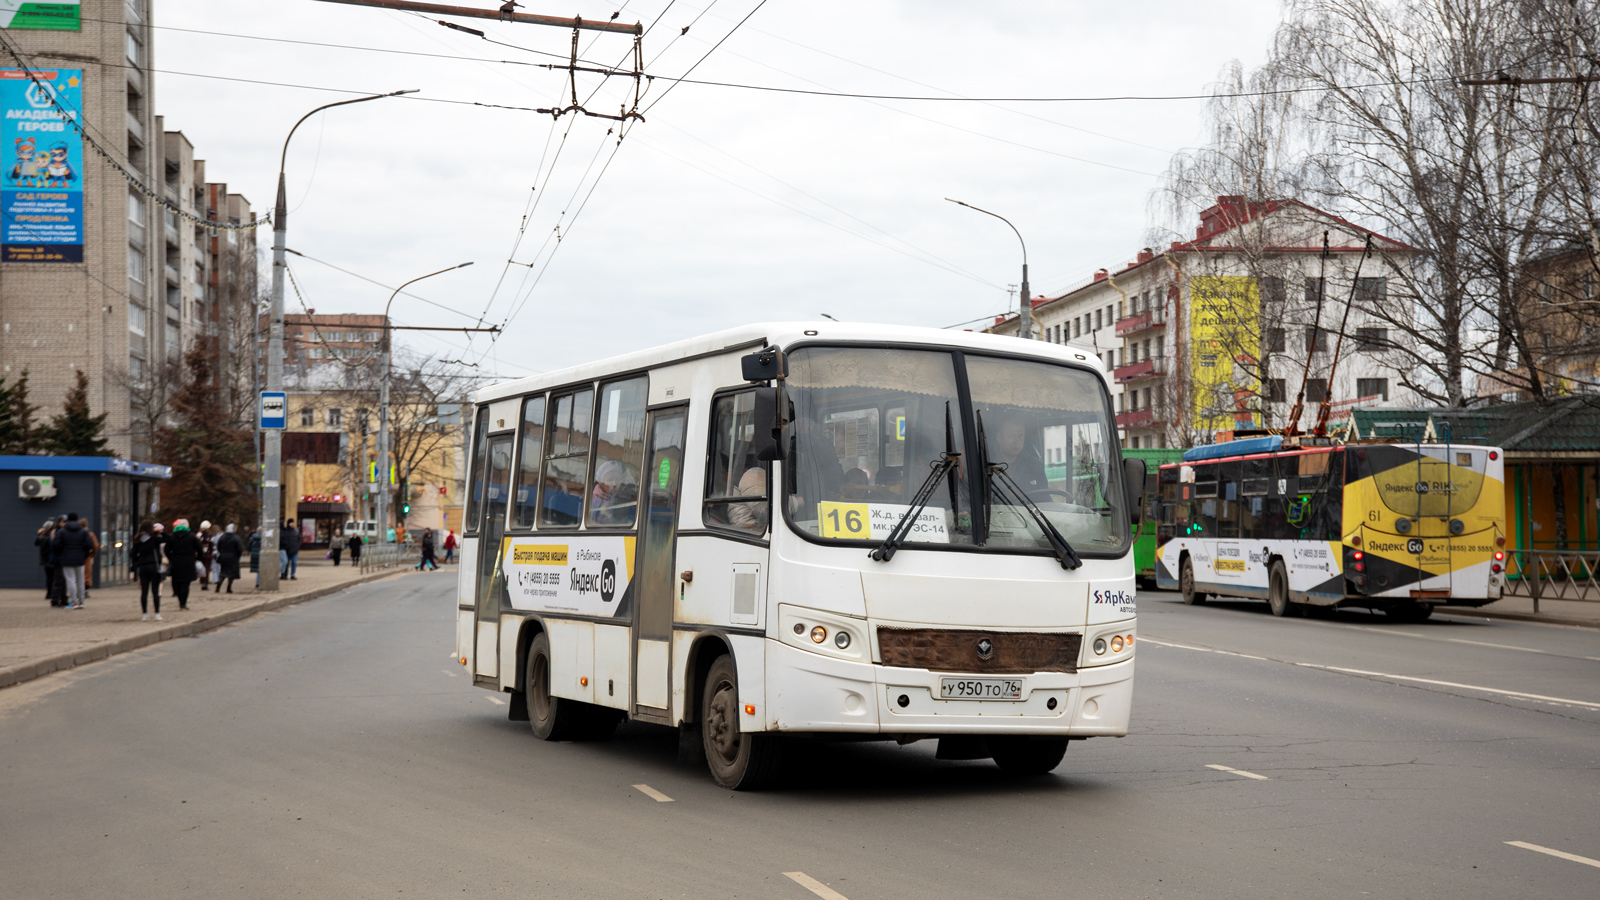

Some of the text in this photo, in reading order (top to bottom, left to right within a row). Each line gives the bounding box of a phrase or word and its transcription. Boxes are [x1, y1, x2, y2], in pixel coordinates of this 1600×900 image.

[18, 122, 65, 132] ГЕРОЕВ
[16, 192, 35, 200] САД
[1385, 483, 1413, 492] Яндекс
[828, 508, 862, 533] 16
[871, 510, 895, 520] Ж.д.
[1368, 510, 1380, 522] 61
[908, 523, 944, 533] ЭС-14
[1369, 541, 1422, 552] Яндекс Go
[514, 548, 567, 563] Быстрая подача машин
[577, 549, 601, 561] в Рыбинске
[524, 572, 529, 583] +7
[543, 572, 548, 584] 20
[570, 567, 614, 595] Яндекс Go
[948, 681, 1017, 696] У 950 ТО 76
